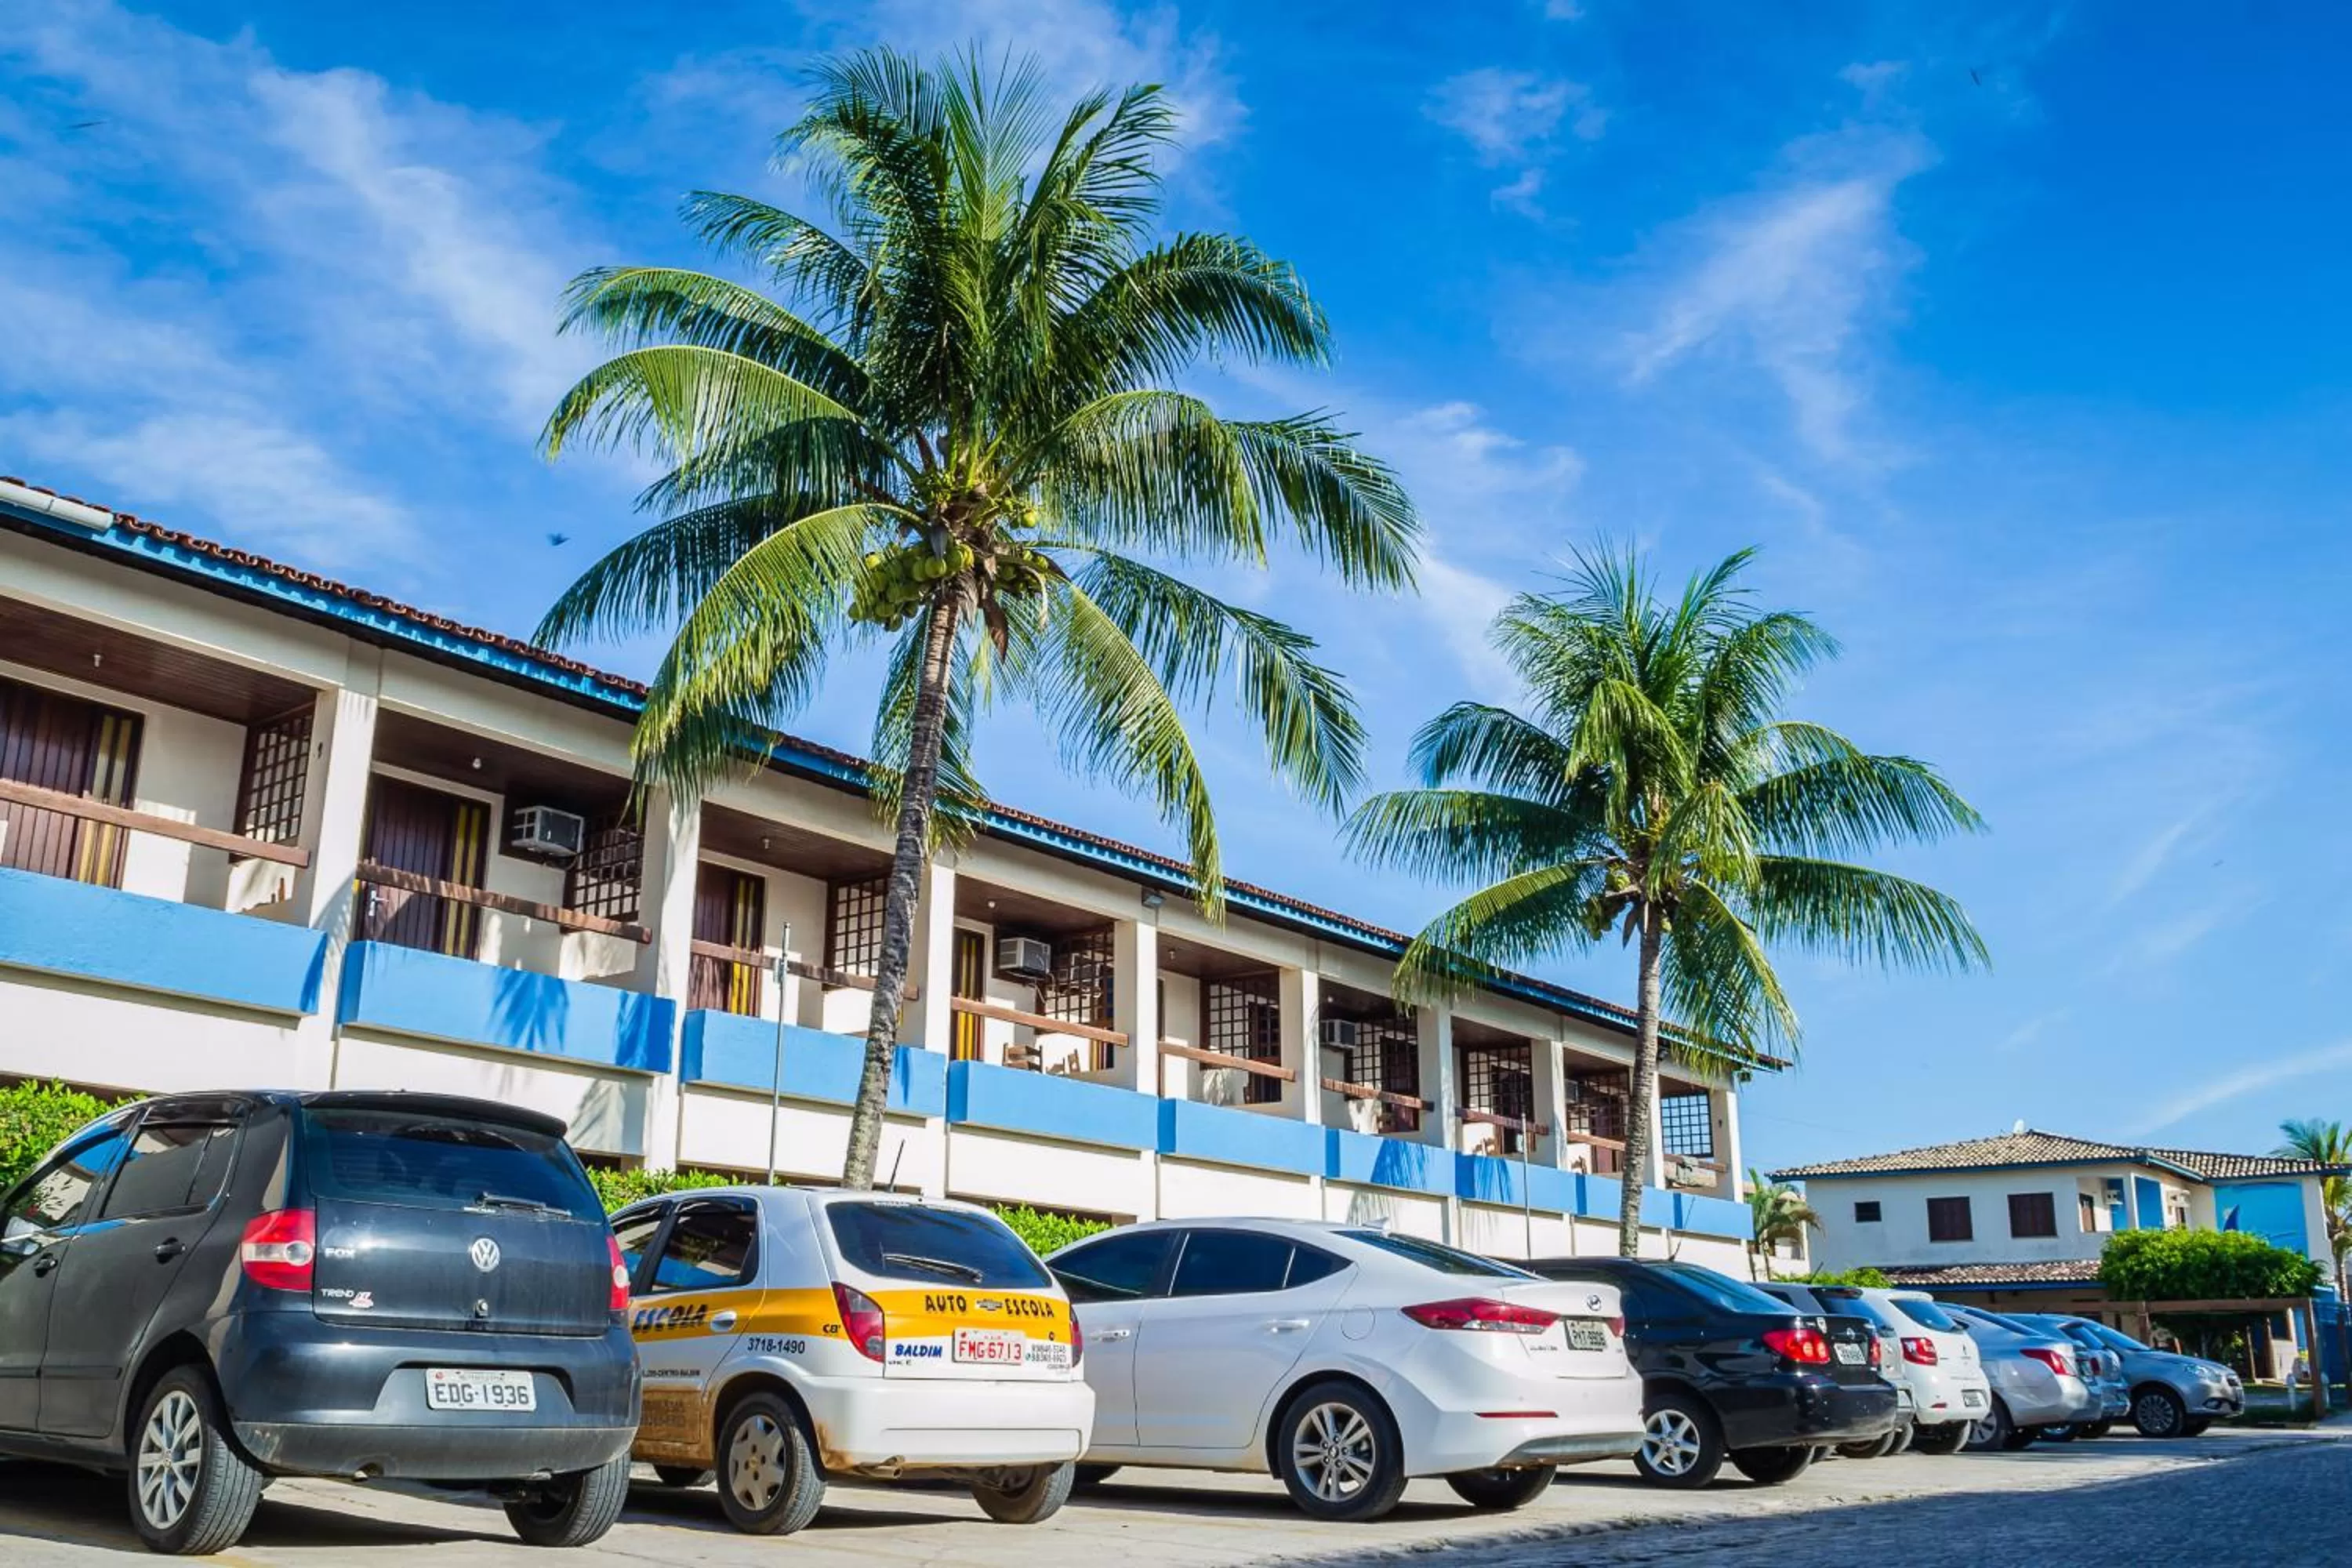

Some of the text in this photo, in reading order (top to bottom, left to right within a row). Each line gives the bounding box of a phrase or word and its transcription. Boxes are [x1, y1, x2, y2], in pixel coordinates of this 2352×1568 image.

[925, 1294, 1054, 1318] AUTO ESCOLA
[746, 1337, 806, 1355] 3718-1490
[895, 1343, 943, 1358] BALDIM
